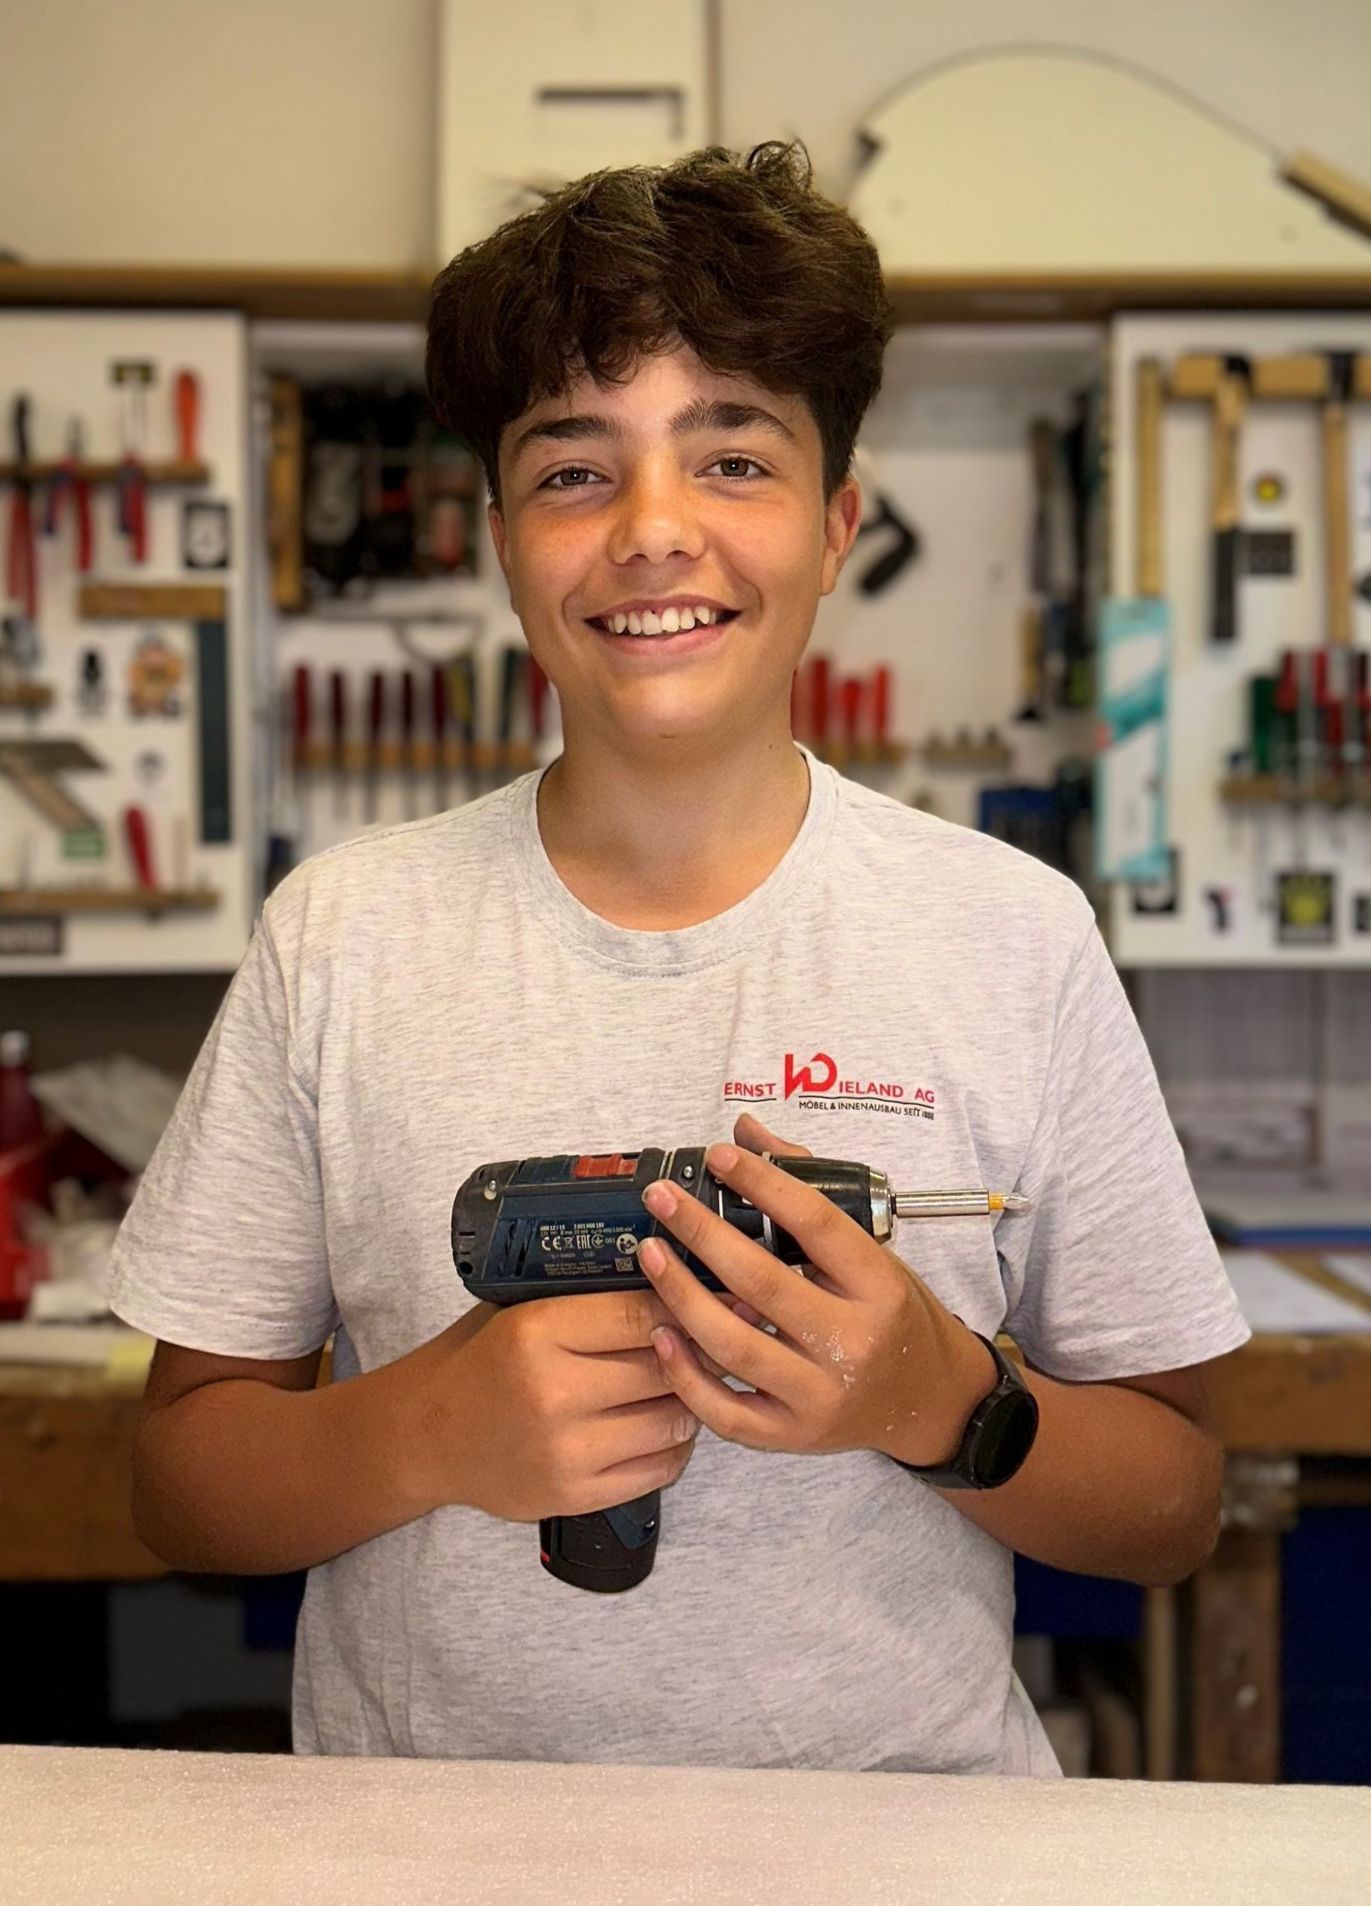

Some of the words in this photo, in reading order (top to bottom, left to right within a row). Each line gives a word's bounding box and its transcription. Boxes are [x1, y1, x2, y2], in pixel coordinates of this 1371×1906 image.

[724, 1082, 777, 1097] ERNST
[914, 1087, 935, 1103] AG
[799, 1100, 829, 1111] MÖBEL
[838, 1102, 901, 1115] INNENAUSBAU
[903, 1107, 921, 1117] SEIT
